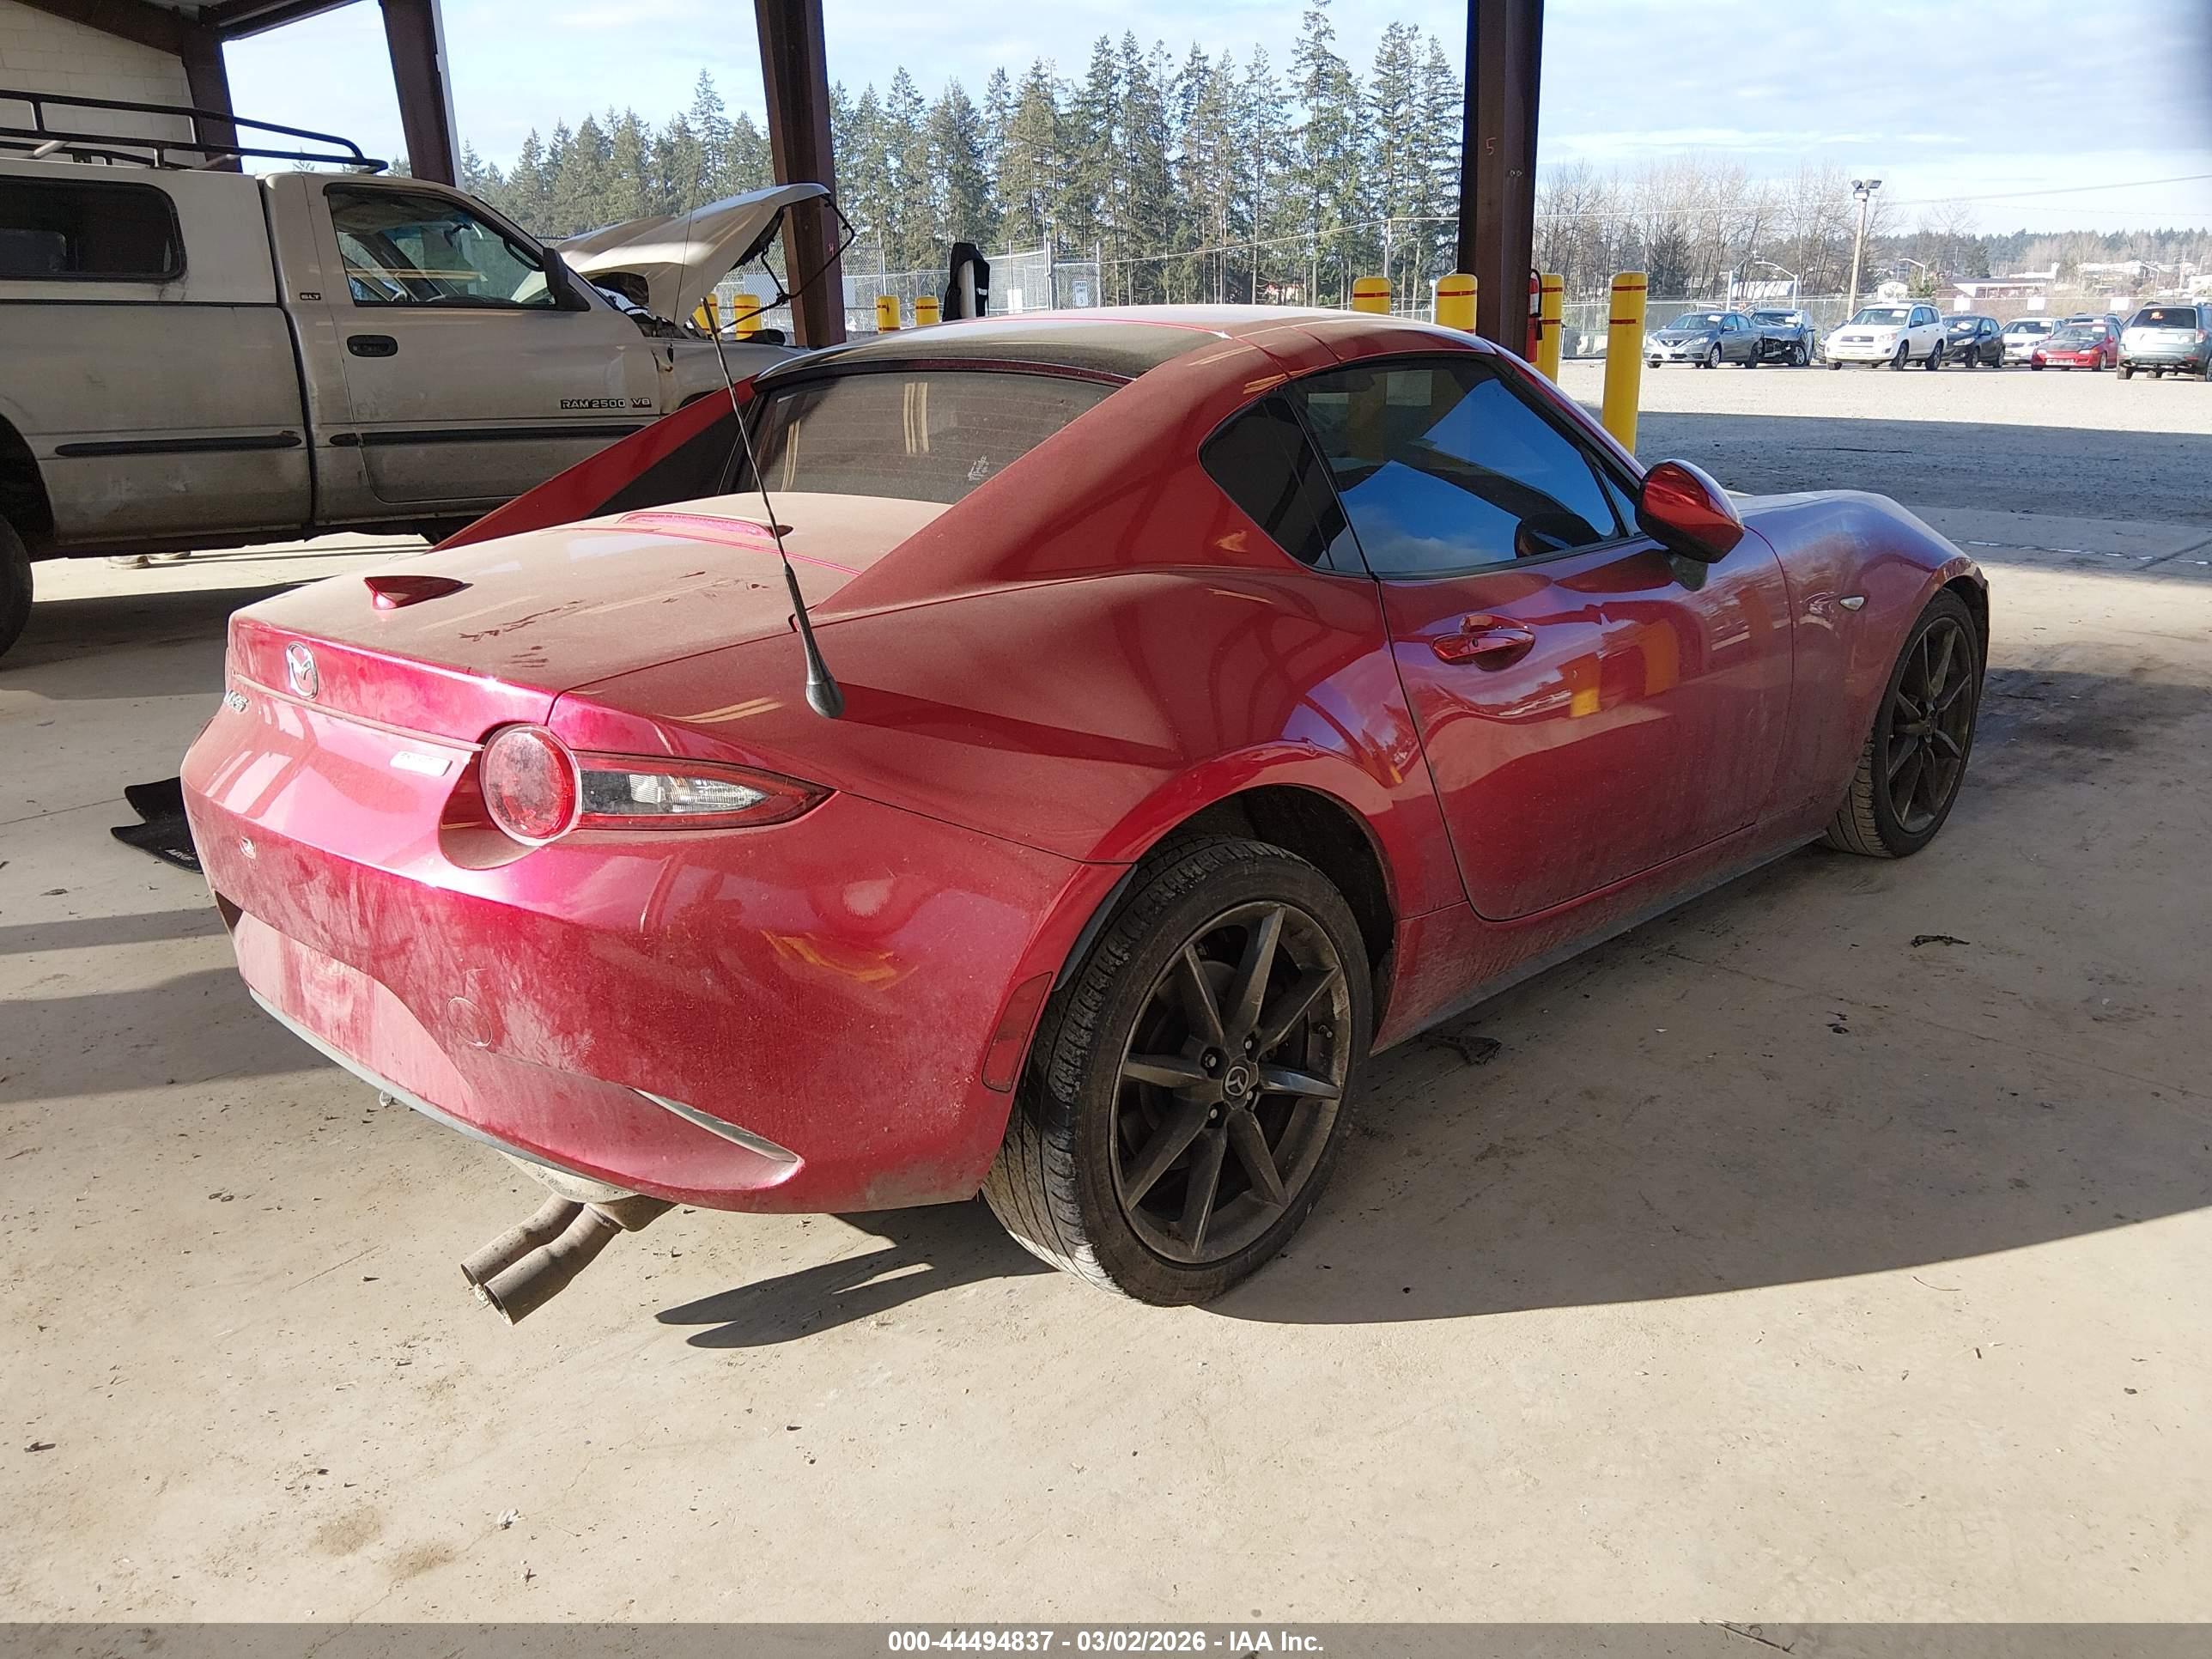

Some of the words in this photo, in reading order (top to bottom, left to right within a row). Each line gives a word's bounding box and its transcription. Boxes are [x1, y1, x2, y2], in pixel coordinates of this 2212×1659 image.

[1486, 137, 1497, 155] 5
[561, 399, 590, 410] RAM
[591, 398, 626, 409] 2500
